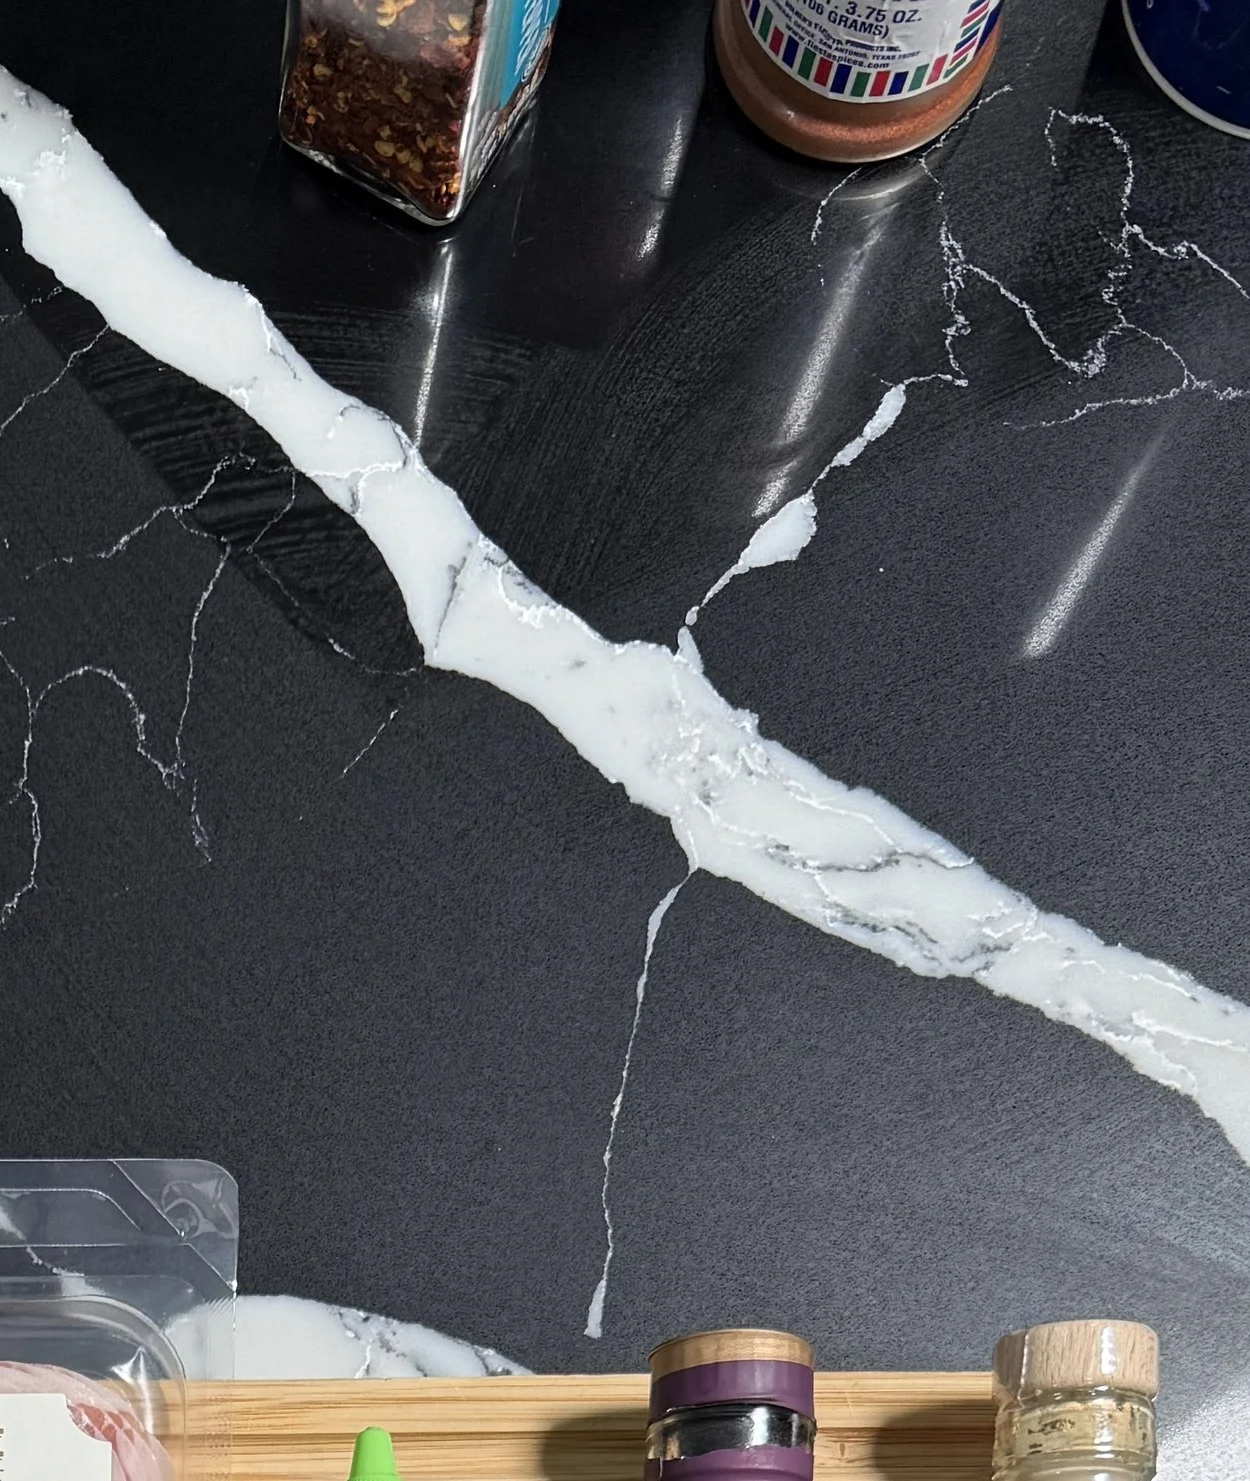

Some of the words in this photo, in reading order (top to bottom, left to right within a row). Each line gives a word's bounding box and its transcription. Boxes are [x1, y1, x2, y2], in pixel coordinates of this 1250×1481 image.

[827, 9, 889, 38] GRAMS)
[845, 0, 886, 22] 3.75
[891, 9, 922, 23] OZ.
